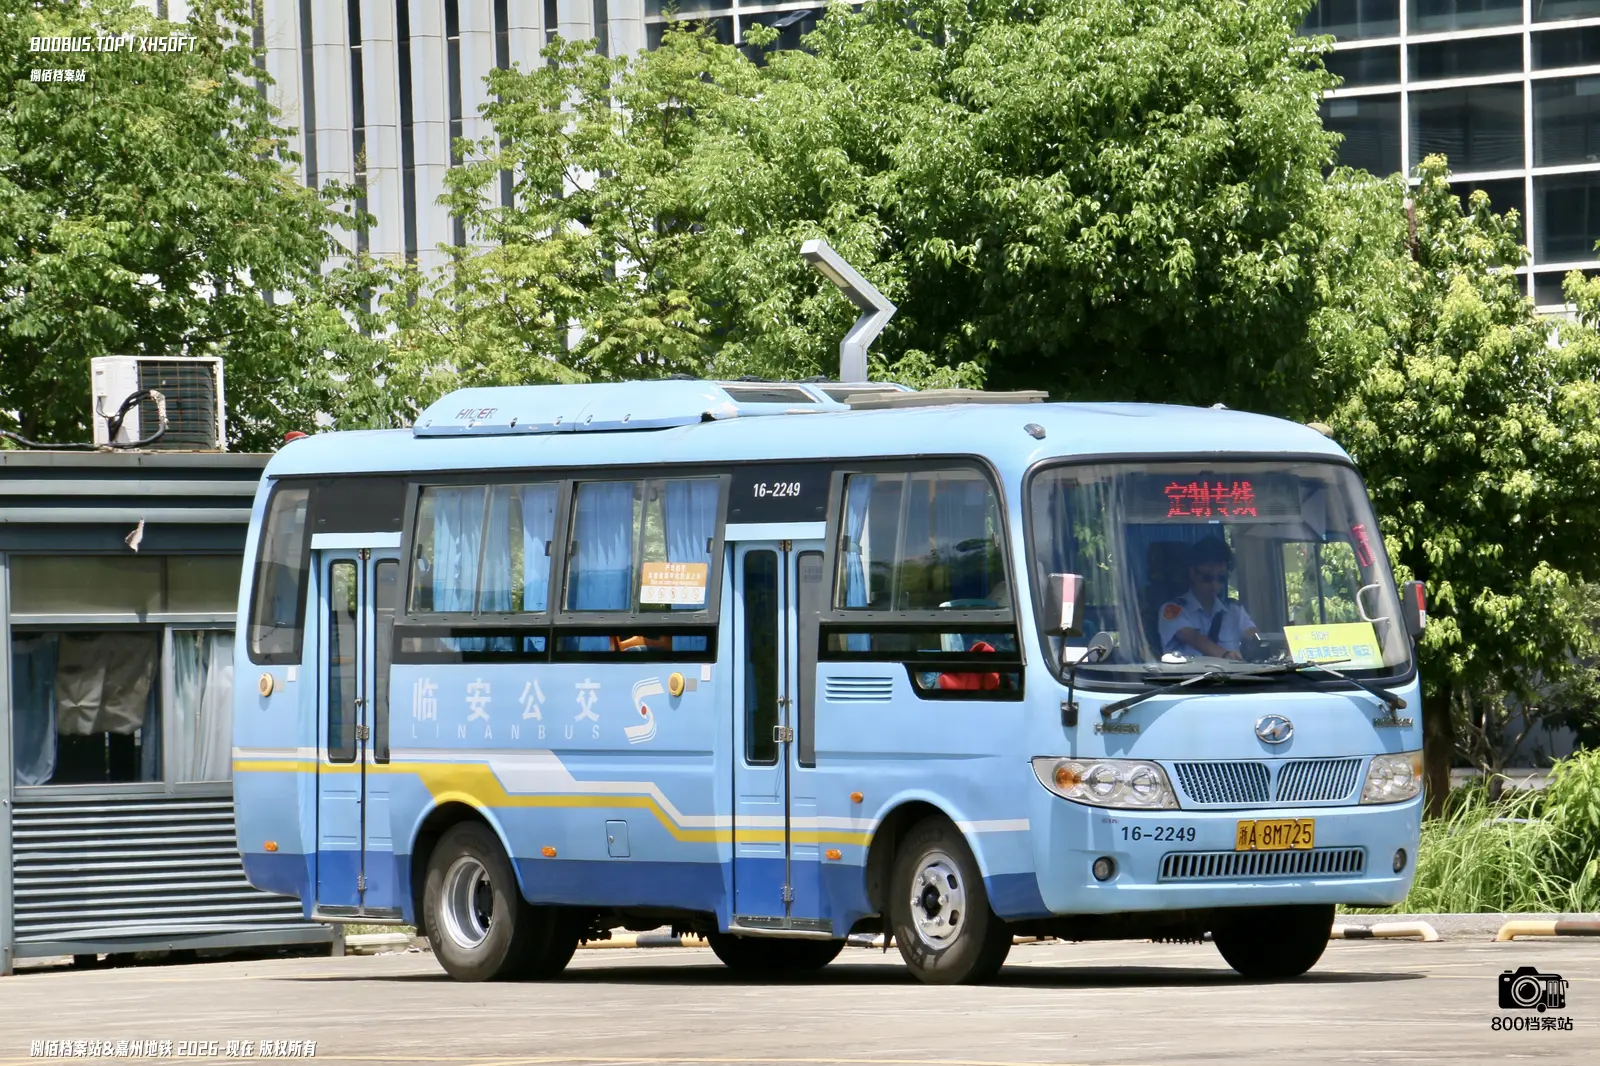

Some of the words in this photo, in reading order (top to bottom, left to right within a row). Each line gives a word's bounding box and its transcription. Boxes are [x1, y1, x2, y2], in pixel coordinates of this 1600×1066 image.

[753, 482, 801, 497] 16-2249
[1164, 481, 1257, 517] 定制专线
[411, 677, 602, 721] 临安公交
[1121, 826, 1196, 842] 16-2249
